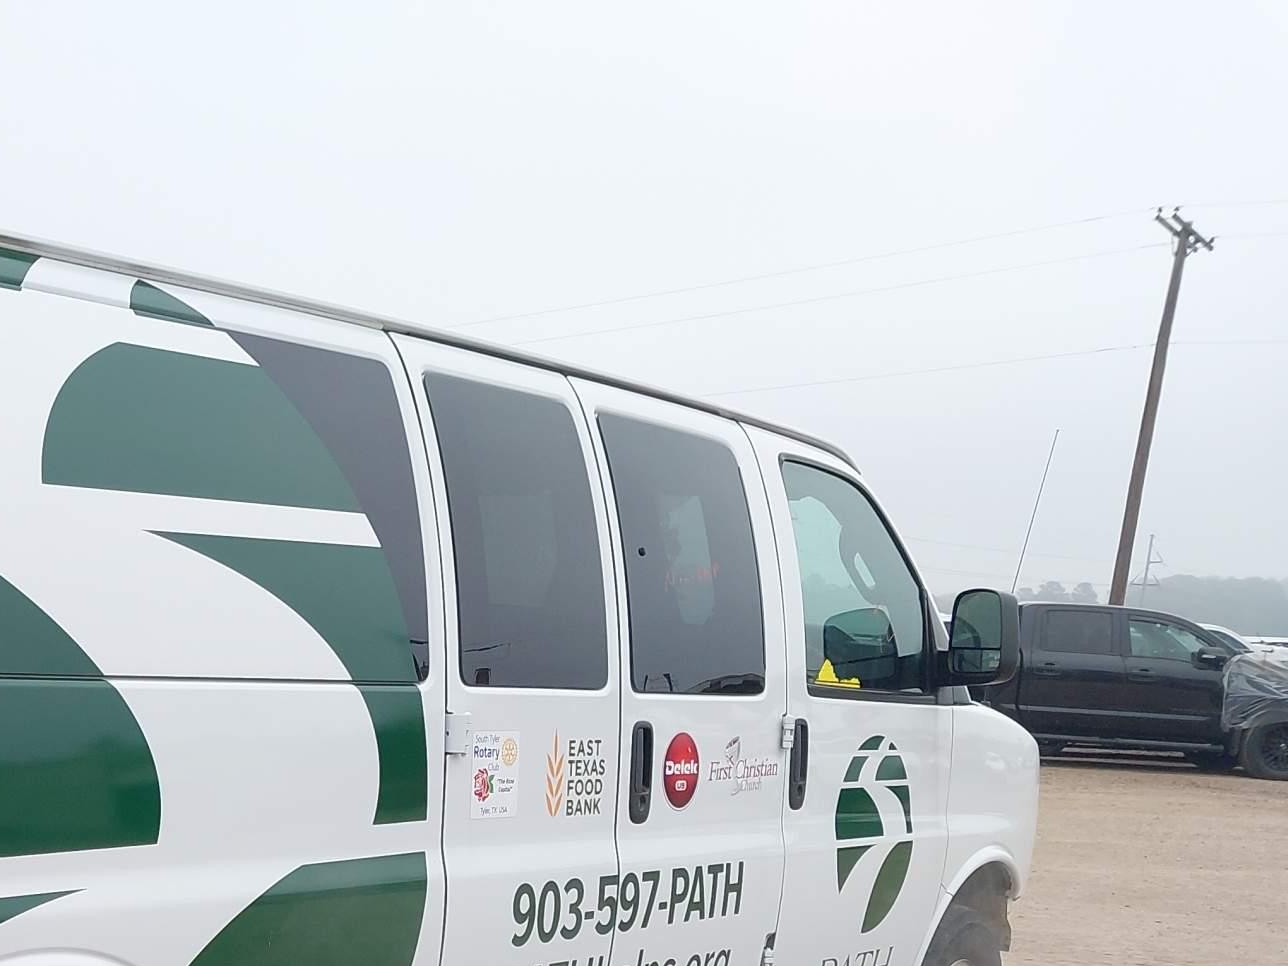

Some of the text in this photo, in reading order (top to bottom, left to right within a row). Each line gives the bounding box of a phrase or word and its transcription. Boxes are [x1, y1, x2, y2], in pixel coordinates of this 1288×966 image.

[474, 745, 500, 760] Rotary
[569, 740, 602, 757] EAST
[568, 760, 605, 776] TEXAS
[665, 760, 698, 775] Delek
[708, 758, 778, 781] First Christian
[567, 779, 603, 797] FOOD
[566, 799, 601, 816] BANK
[511, 861, 745, 947] 903-597-PATH
